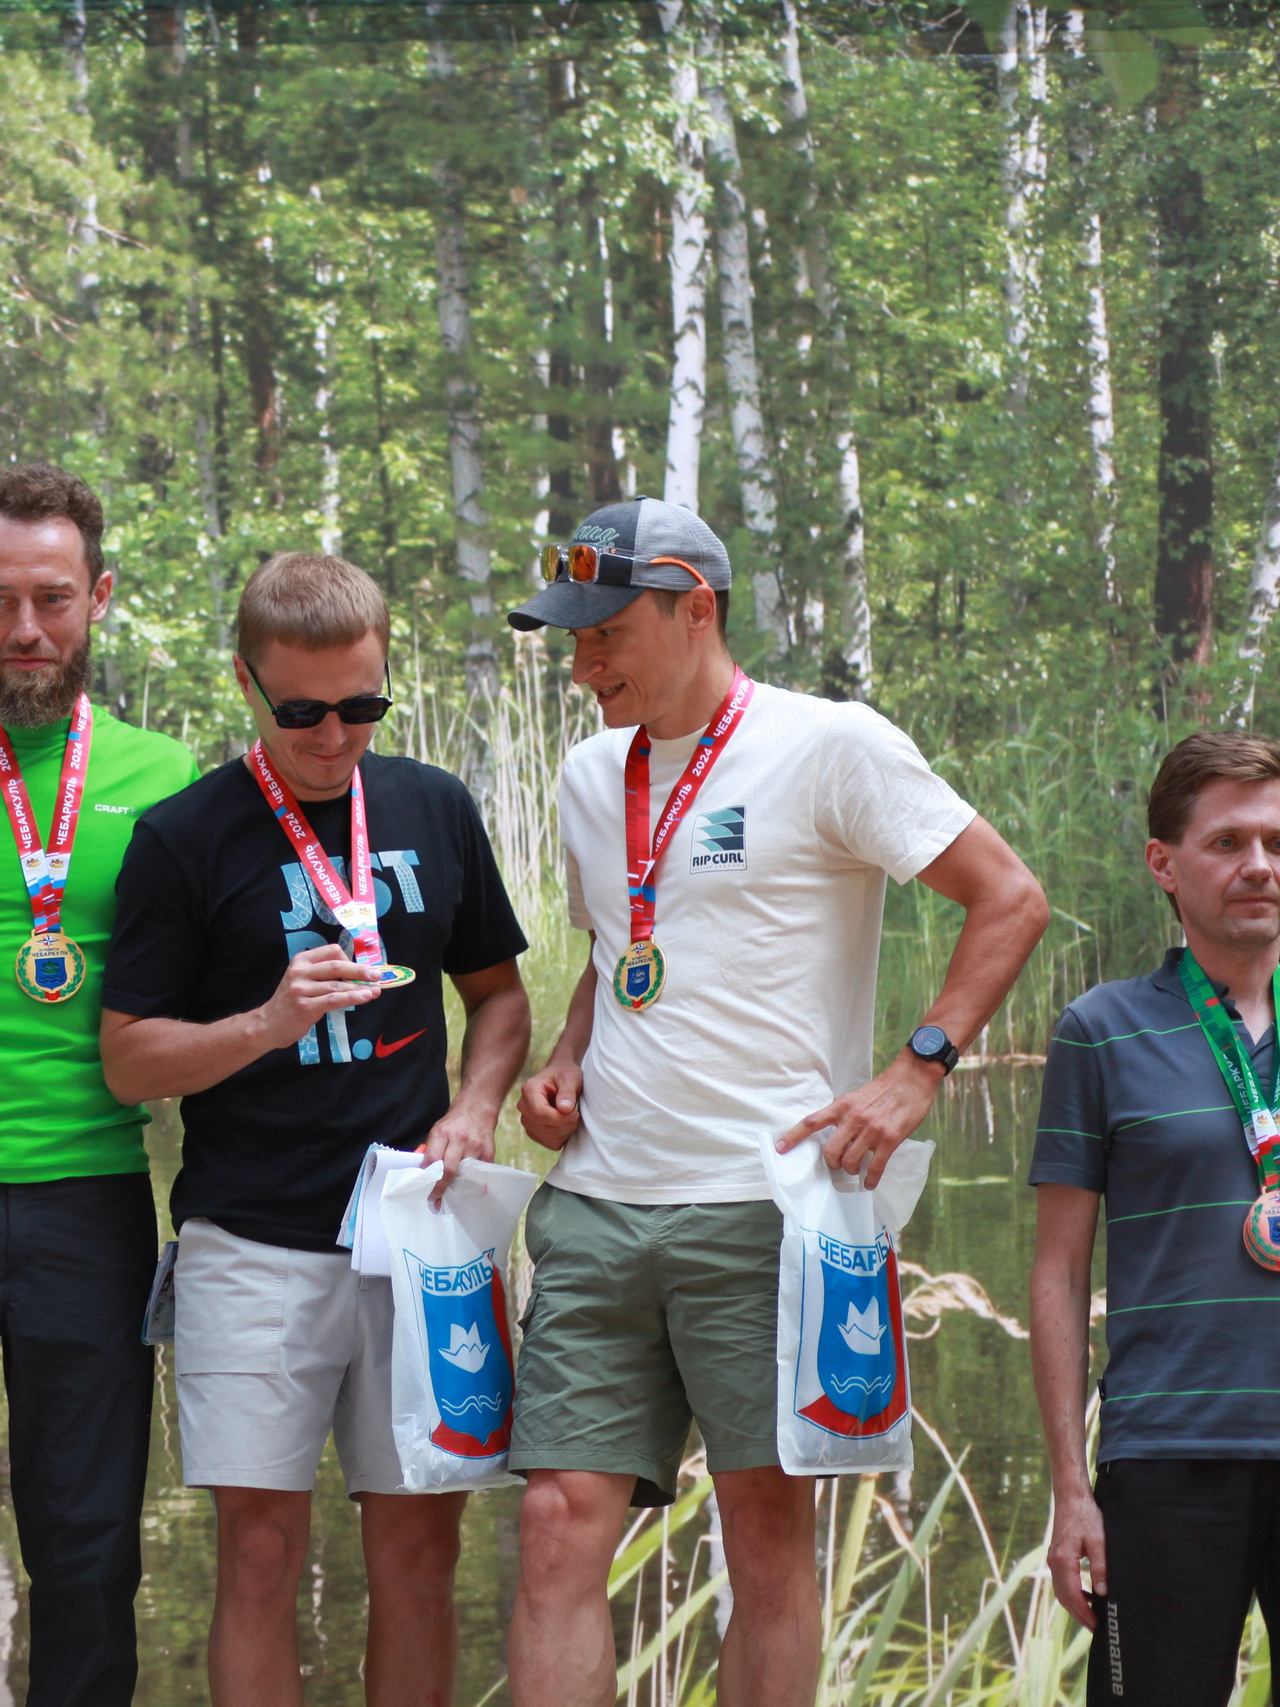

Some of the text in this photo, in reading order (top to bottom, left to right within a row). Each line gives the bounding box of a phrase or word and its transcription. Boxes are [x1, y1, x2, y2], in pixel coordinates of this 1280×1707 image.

[7, 779, 33, 849] ЧЕБАРКУЛЬ
[56, 777, 77, 845] ЧЕБАРКУЛЬ
[70, 742, 84, 770] 2024
[94, 803, 130, 815] CRAFT
[356, 801, 364, 828] 2024
[654, 783, 692, 852] ЧЕБАРКУЛЬ
[692, 747, 713, 777] 2024
[285, 812, 306, 839] 2024
[305, 845, 343, 905] ЧЕБАРКУЛЬ
[357, 834, 368, 896] ЧЕБАРКУЛЬ
[692, 855, 711, 867] RIP
[712, 852, 744, 864] CURL
[1107, 1600, 1124, 1697] noname
